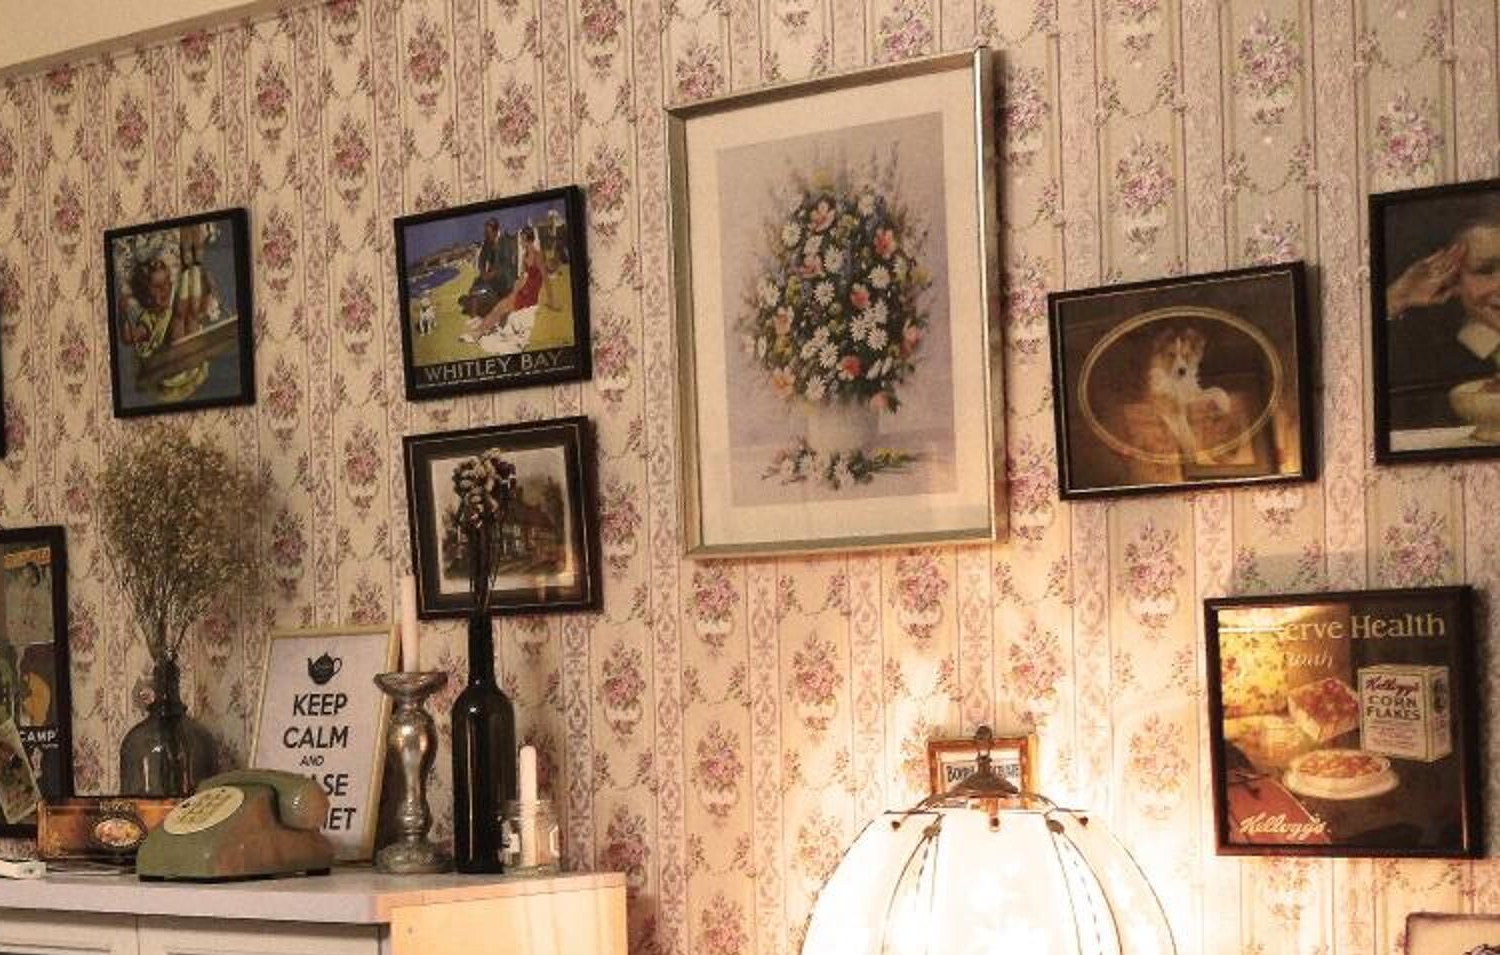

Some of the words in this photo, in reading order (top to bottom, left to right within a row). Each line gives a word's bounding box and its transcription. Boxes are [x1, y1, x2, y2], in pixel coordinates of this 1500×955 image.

[424, 356, 513, 383] WHITLEY
[521, 350, 562, 371] BAY
[1278, 620, 1344, 641] erve
[1351, 613, 1445, 640] Health
[293, 693, 348, 716] KEEP
[1365, 705, 1421, 721] FLAKES
[1368, 695, 1418, 709] CORN
[283, 725, 349, 749] CALM
[300, 755, 324, 767] AND
